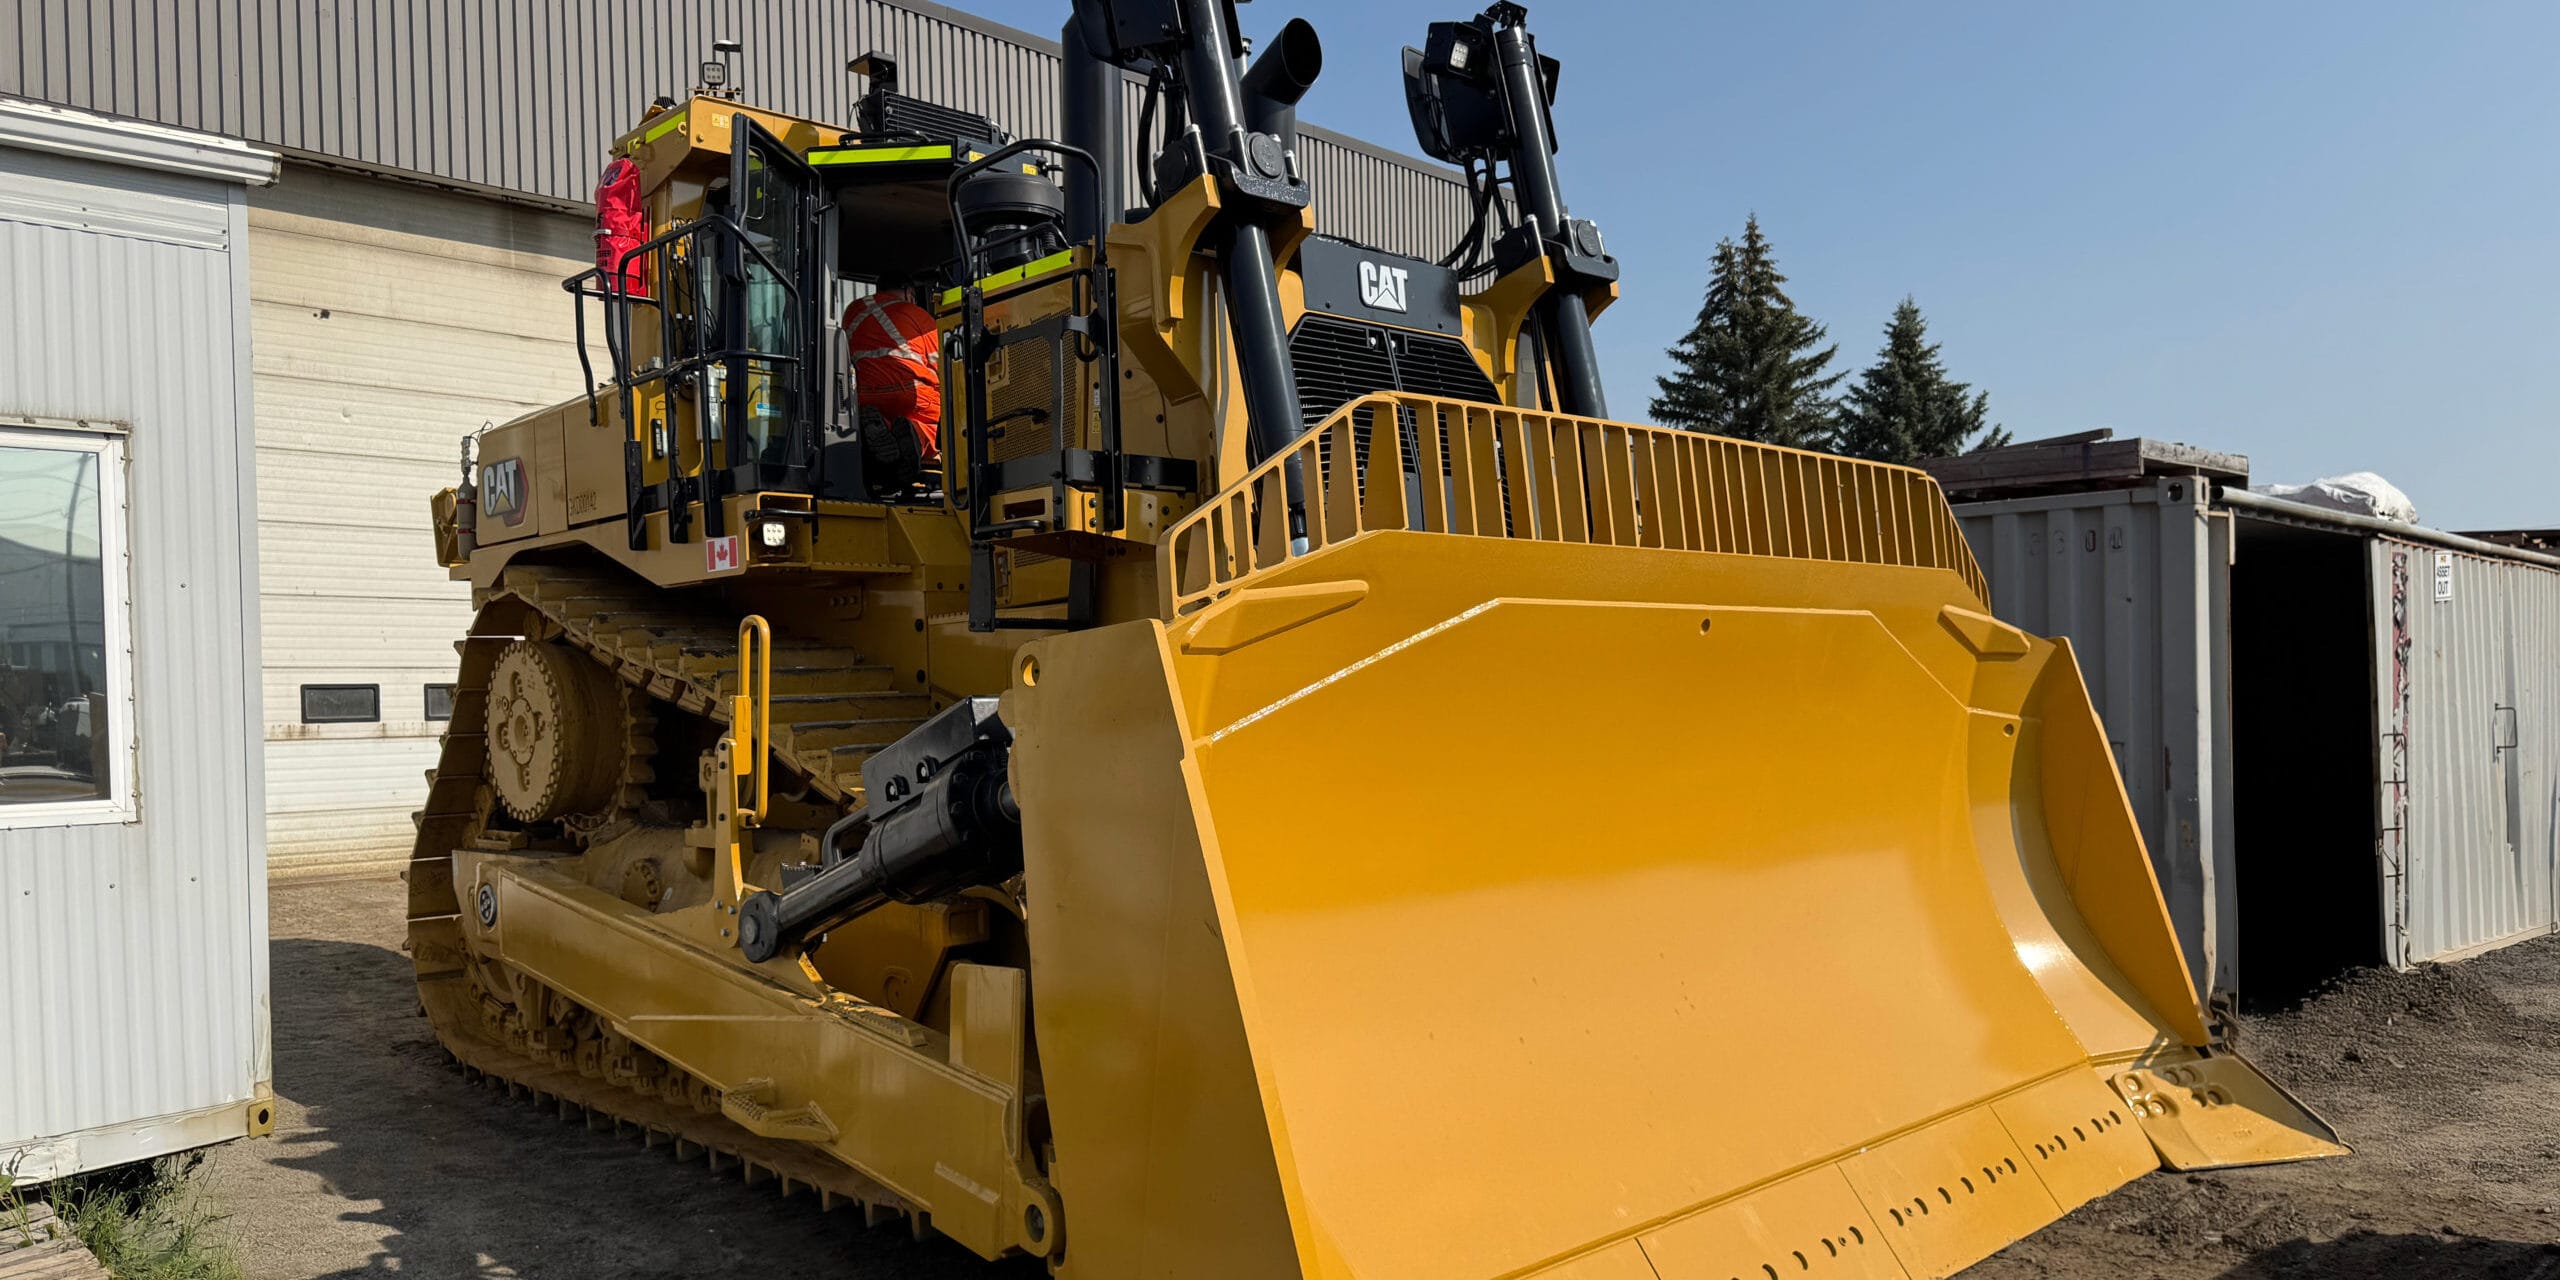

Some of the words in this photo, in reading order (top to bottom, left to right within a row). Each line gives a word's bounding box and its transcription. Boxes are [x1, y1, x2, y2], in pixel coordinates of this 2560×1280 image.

[1359, 260, 1408, 312] CAT
[483, 459, 517, 516] CAT
[2437, 580, 2449, 595] OUT
